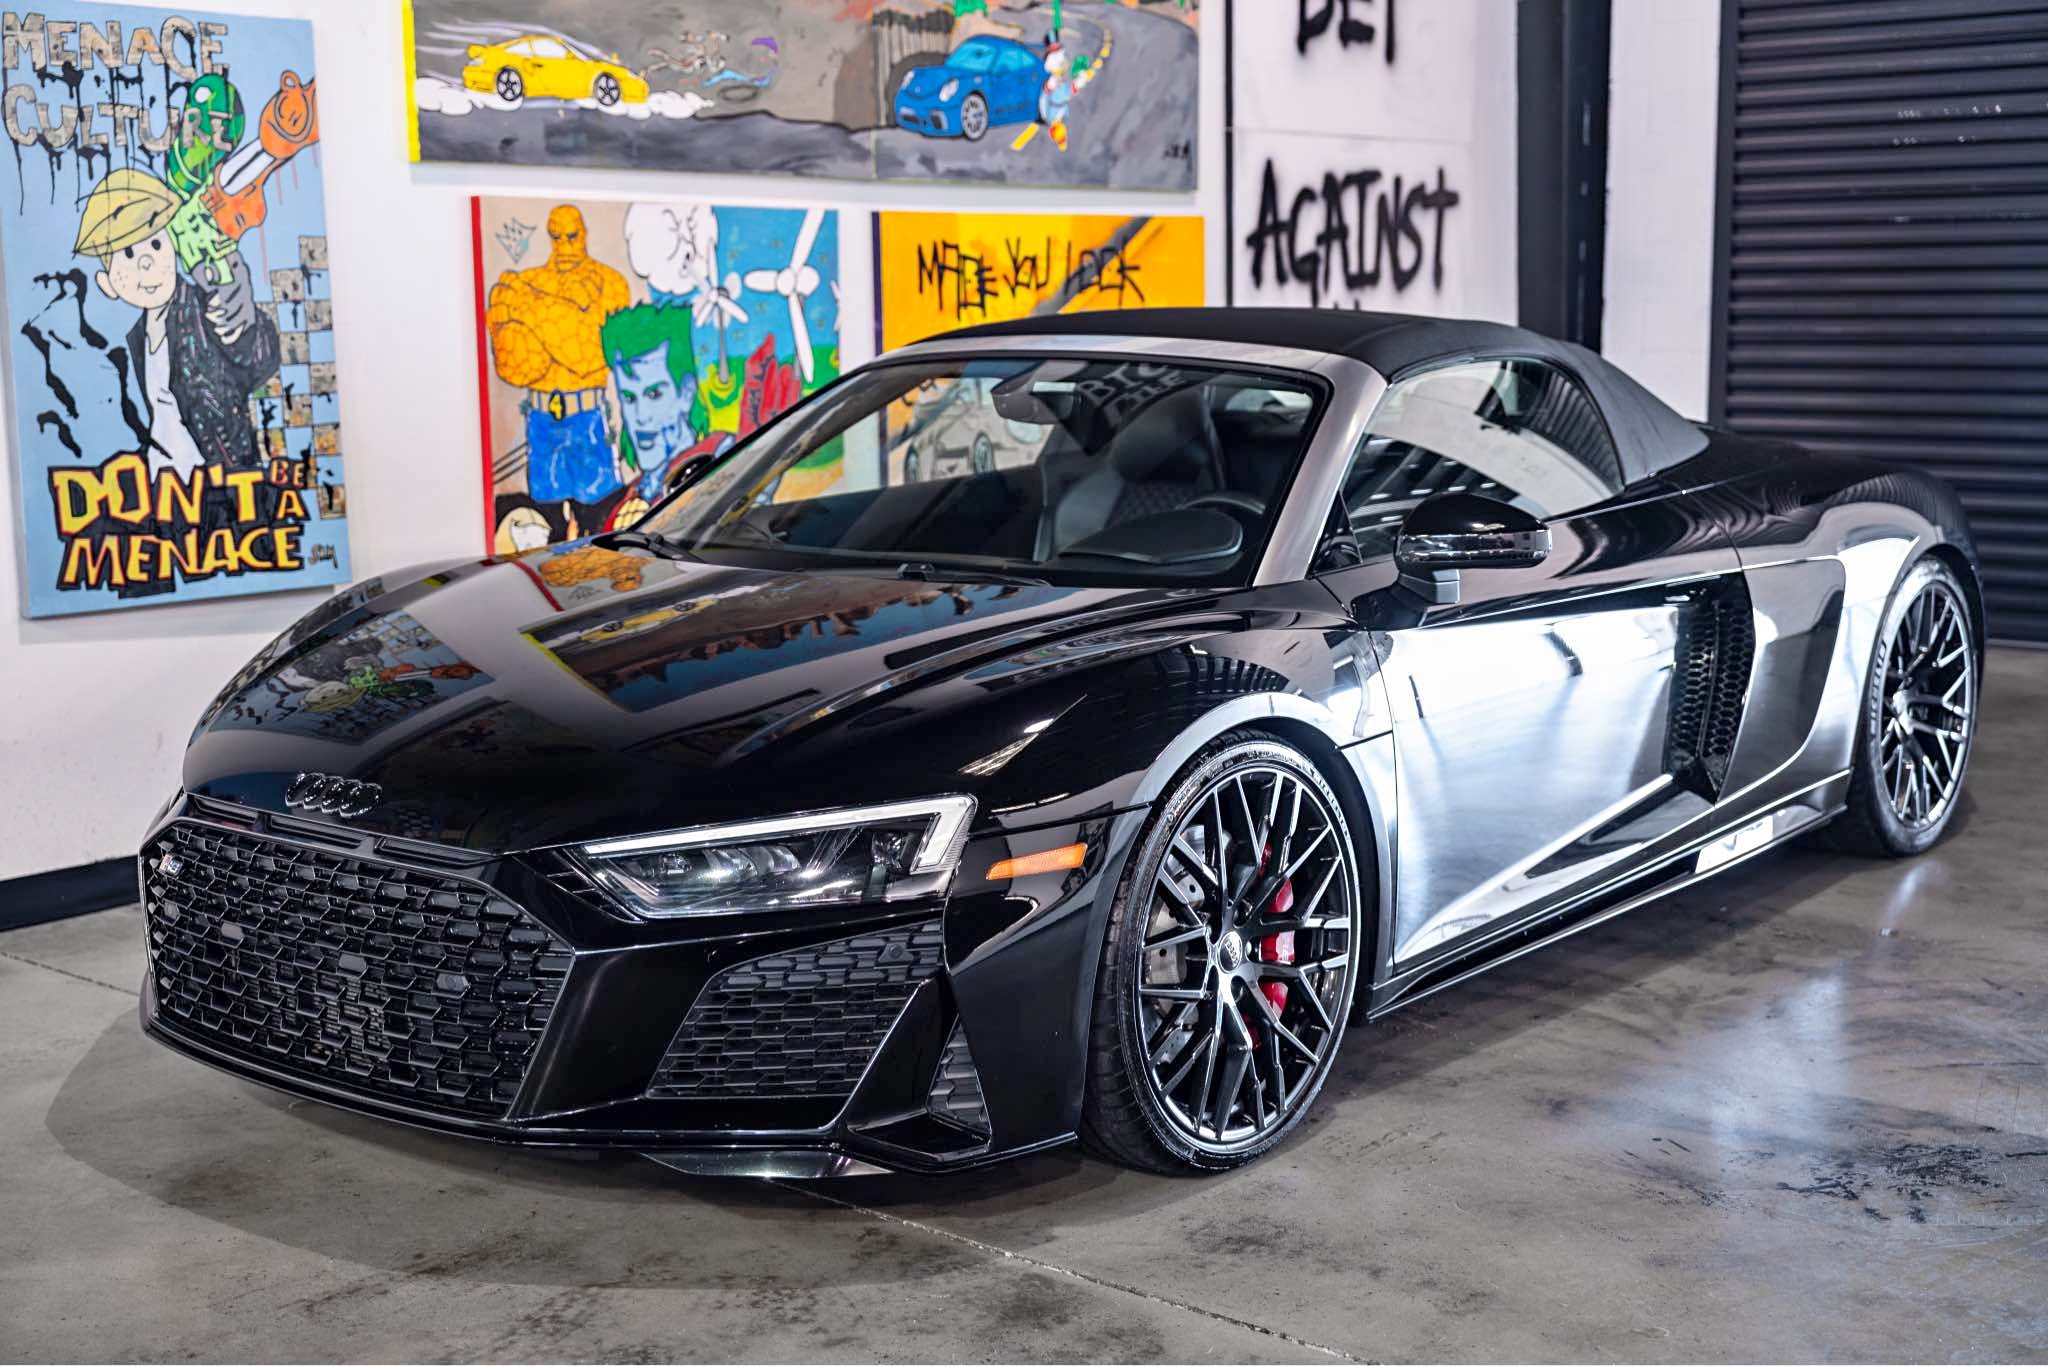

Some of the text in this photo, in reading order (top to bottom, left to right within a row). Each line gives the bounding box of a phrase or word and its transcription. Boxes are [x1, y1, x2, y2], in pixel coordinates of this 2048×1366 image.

[2, 12, 230, 79] MENACE
[4, 84, 233, 152] CULTURE
[1246, 157, 1460, 297] AGAINST
[51, 451, 305, 535] DON'T BE A
[62, 525, 301, 587] MENACE
